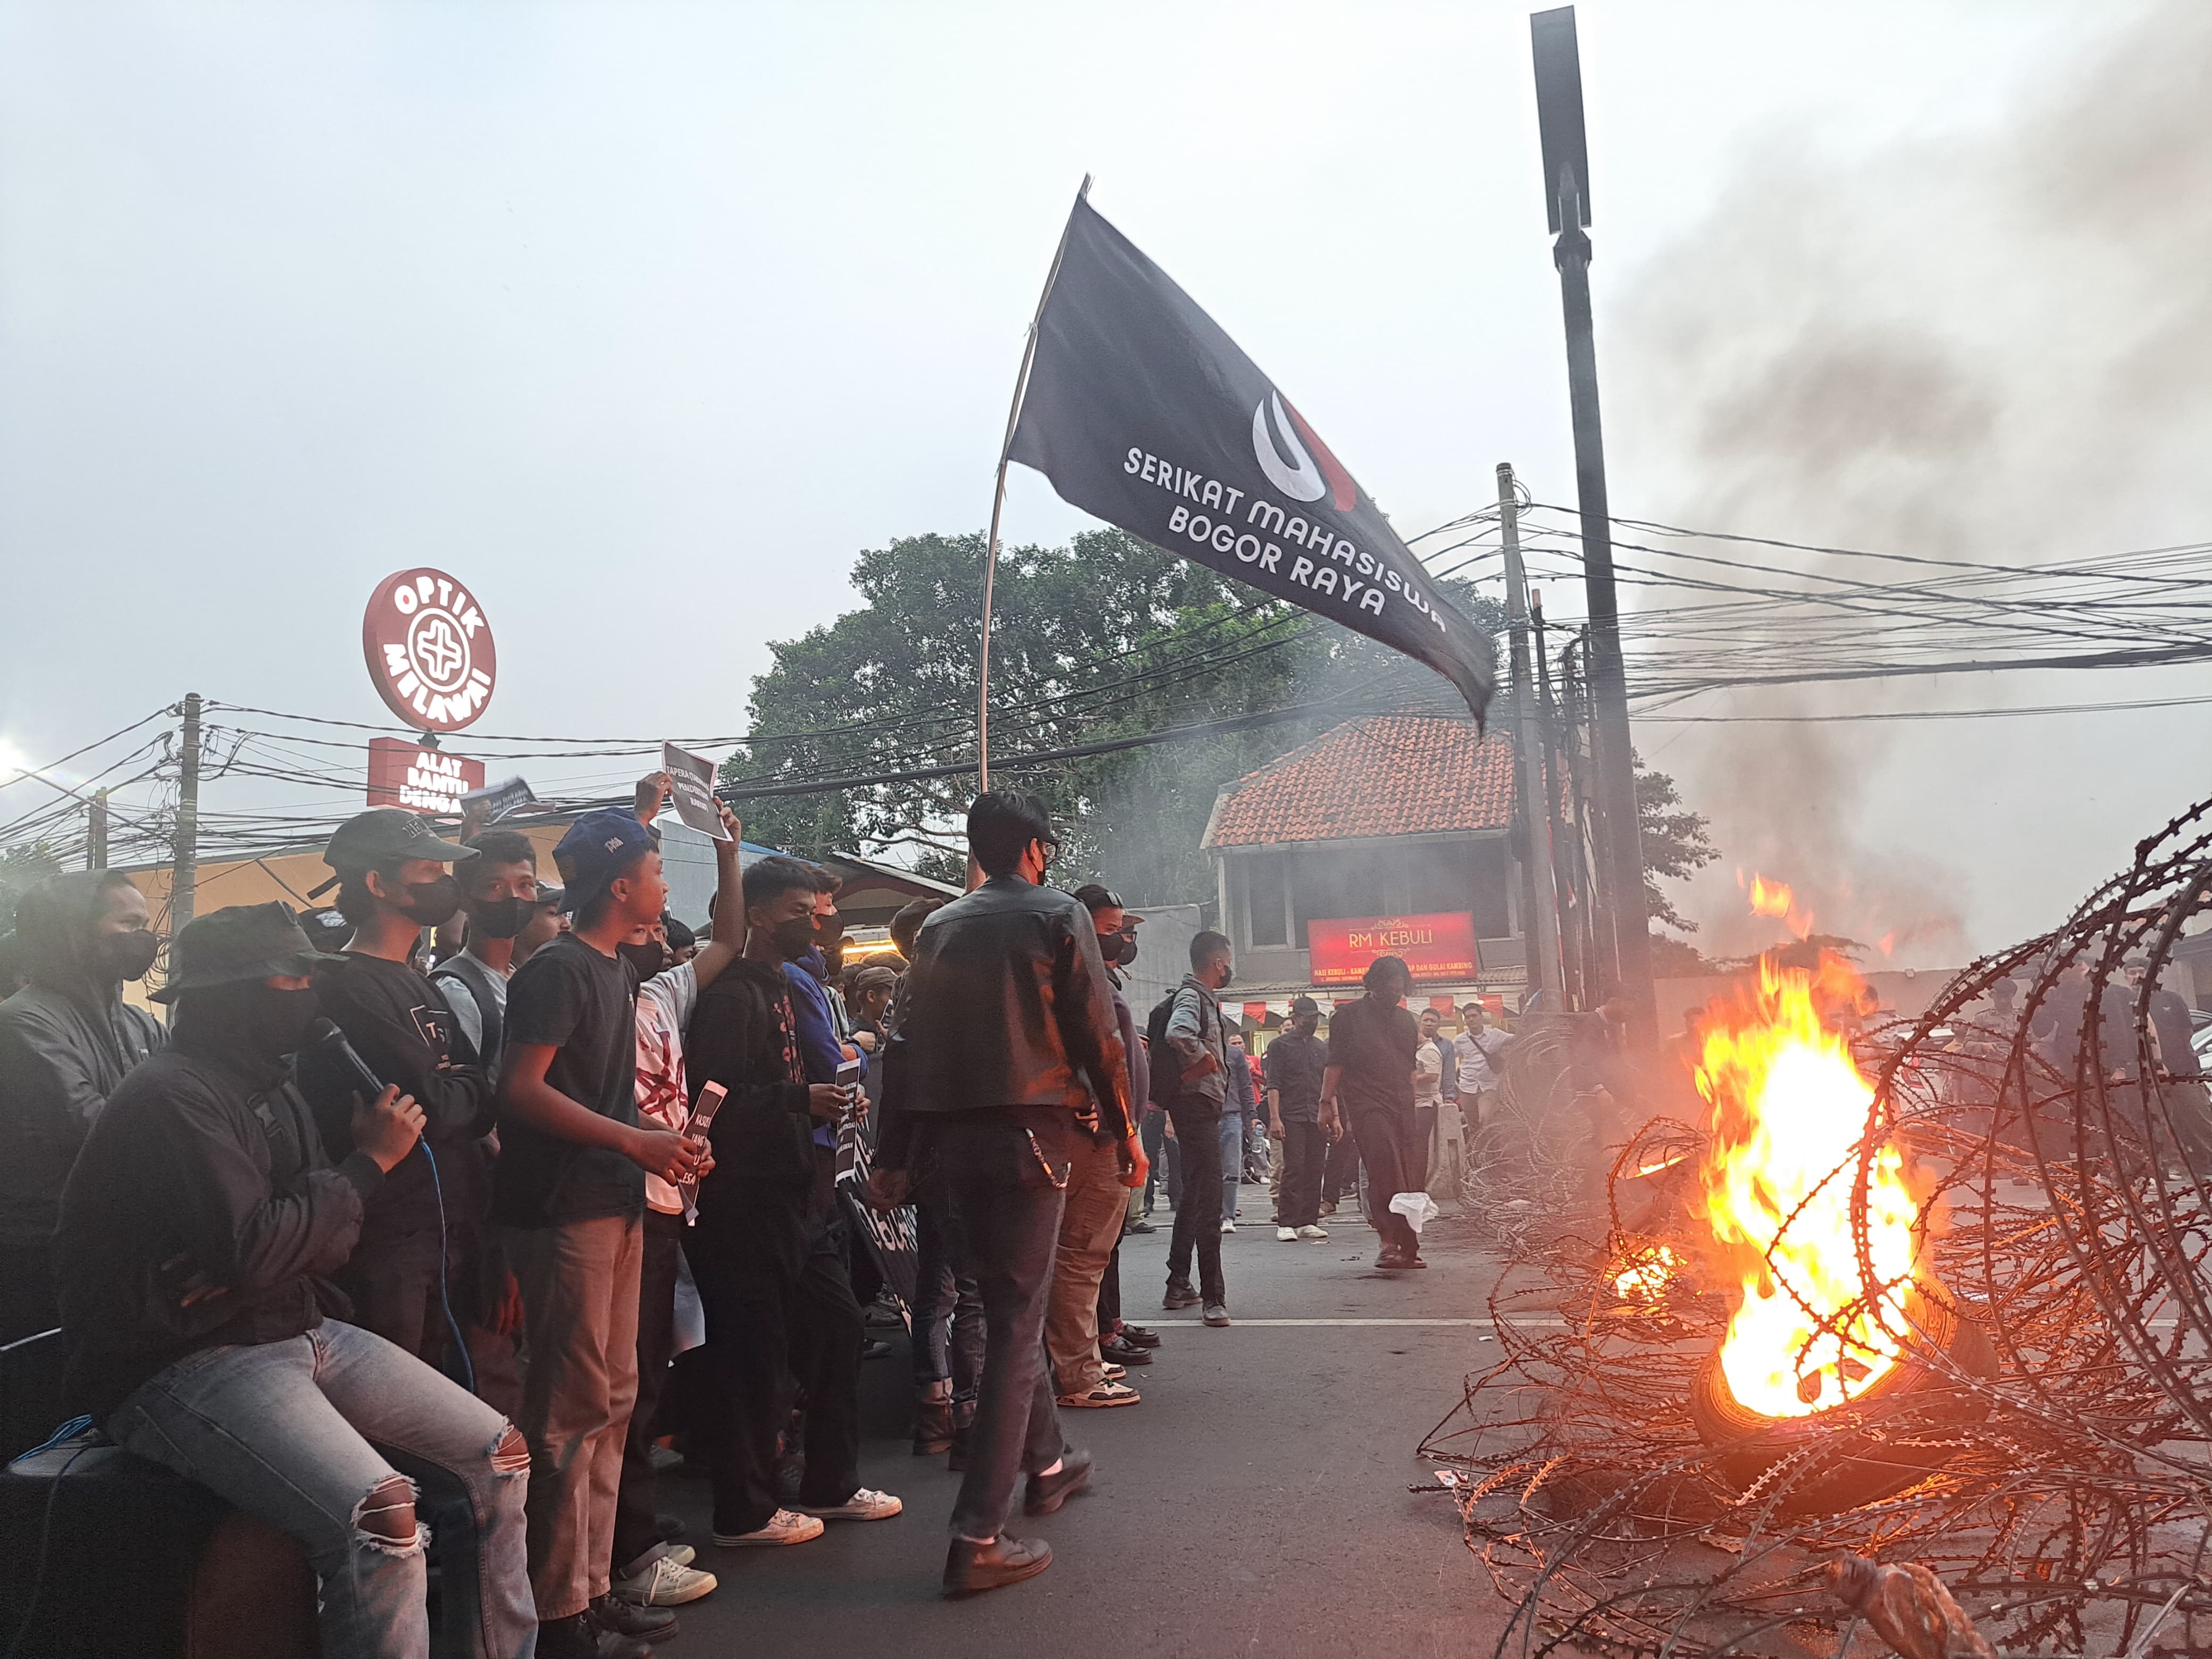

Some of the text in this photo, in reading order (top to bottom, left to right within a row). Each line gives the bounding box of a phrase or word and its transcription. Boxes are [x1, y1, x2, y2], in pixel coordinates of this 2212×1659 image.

[1124, 447, 1446, 633] SERIKAT MAHASISWA
[1169, 505, 1385, 616] BOGOR RAYA
[394, 575, 485, 639] OPTIK
[383, 643, 491, 723] MELAWAI
[416, 752, 462, 778] ALAT
[666, 765, 690, 779] TAPERA
[407, 767, 468, 794] BANTU
[399, 784, 462, 813] DENGA
[1349, 929, 1432, 948] RM KEBULI
